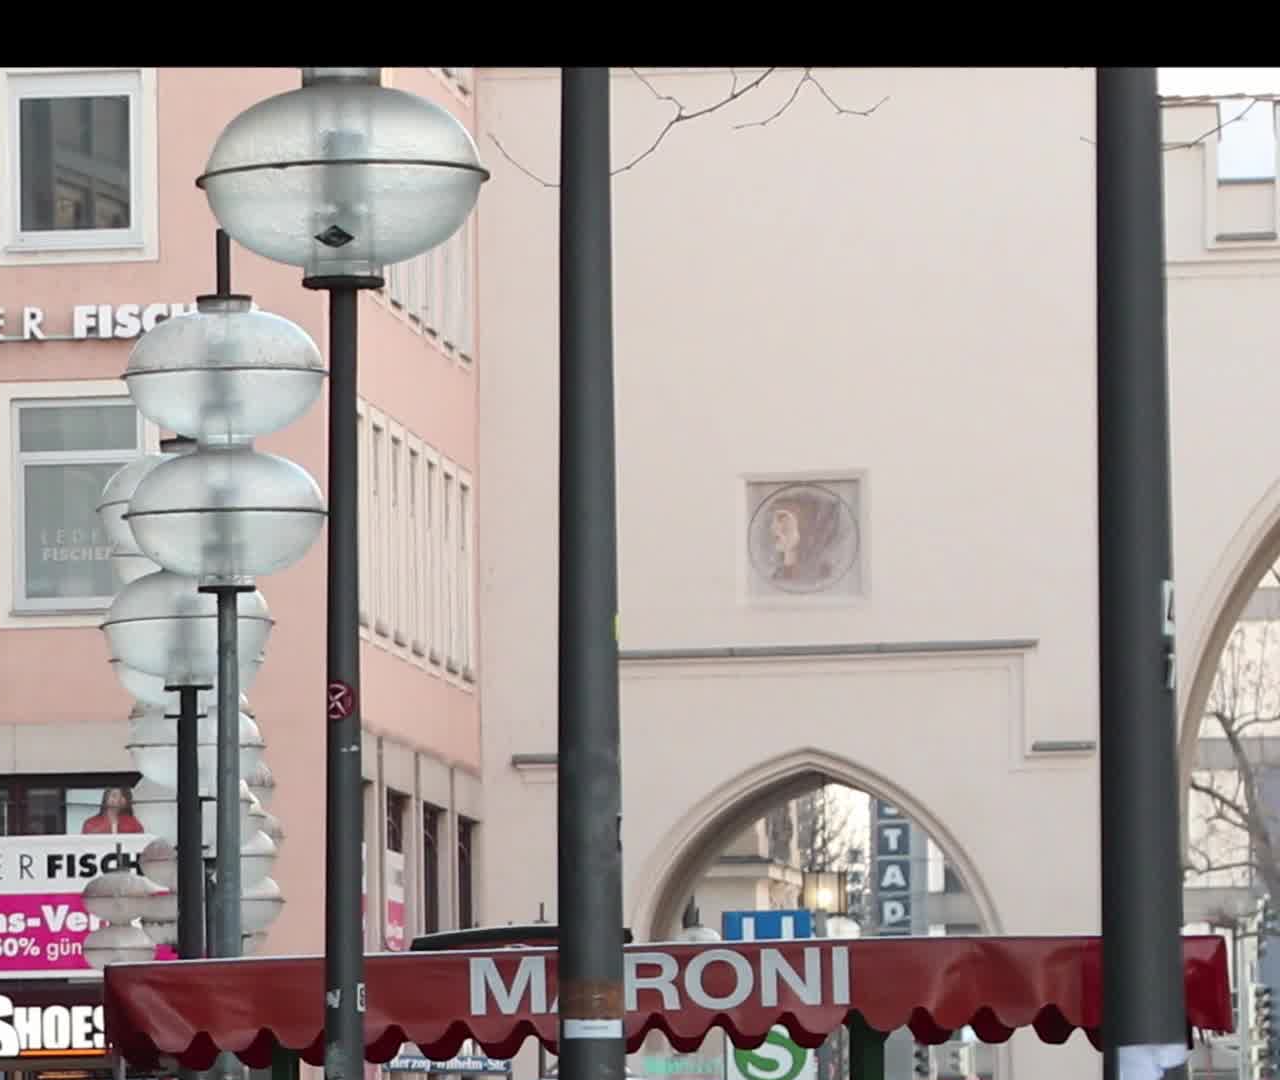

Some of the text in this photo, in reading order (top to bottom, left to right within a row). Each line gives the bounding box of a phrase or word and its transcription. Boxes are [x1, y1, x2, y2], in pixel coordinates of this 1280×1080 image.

[73, 302, 197, 339] FISC
[46, 936, 82, 959] gün
[468, 946, 851, 1016] MRONI
